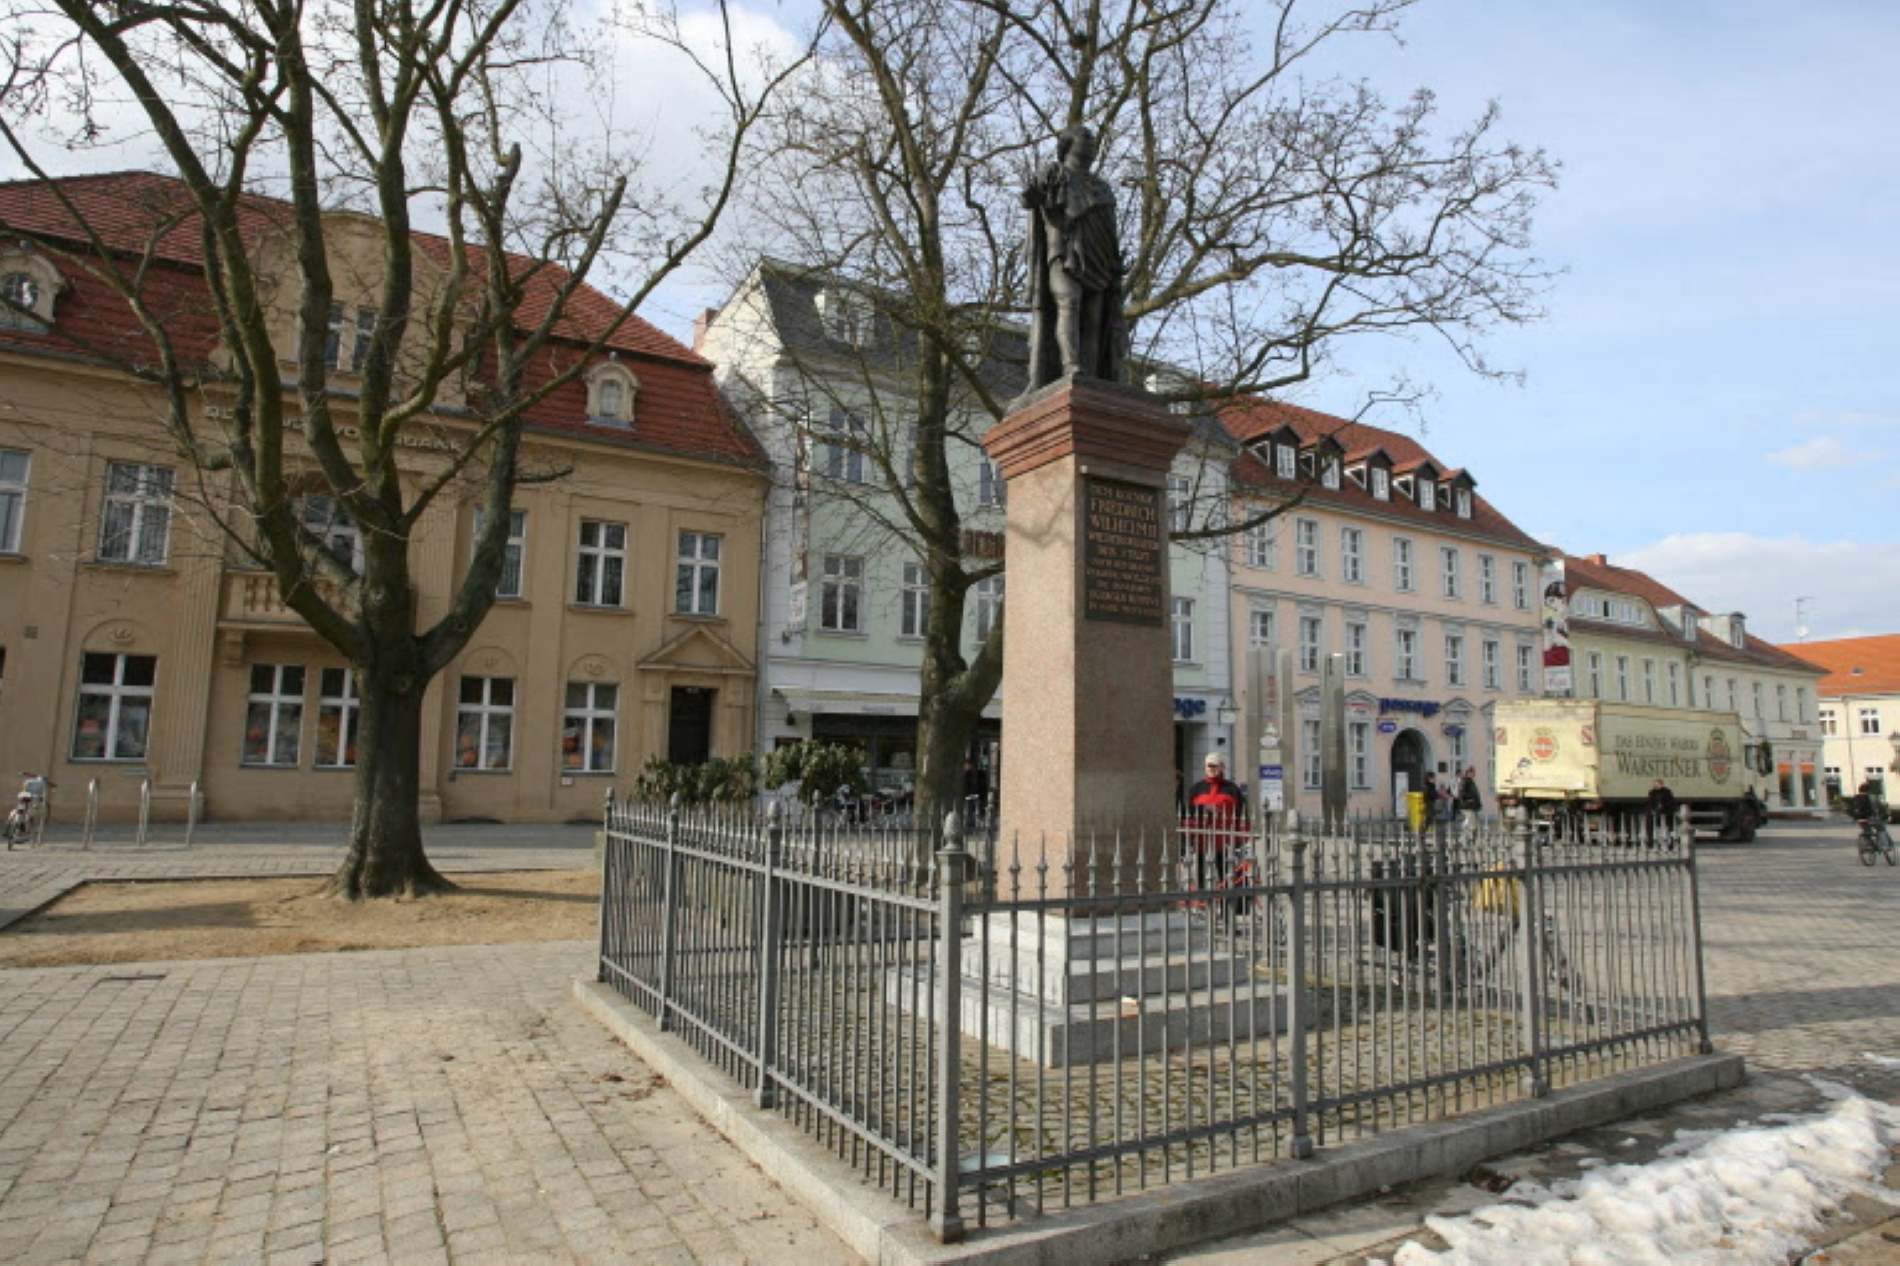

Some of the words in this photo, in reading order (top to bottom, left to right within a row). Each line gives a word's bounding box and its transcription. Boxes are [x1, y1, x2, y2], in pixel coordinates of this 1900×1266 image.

[1091, 498, 1155, 520] FRIEDRICH
[1089, 514, 1147, 536] WILHELM
[1614, 750, 1701, 778] WARSTEINER
